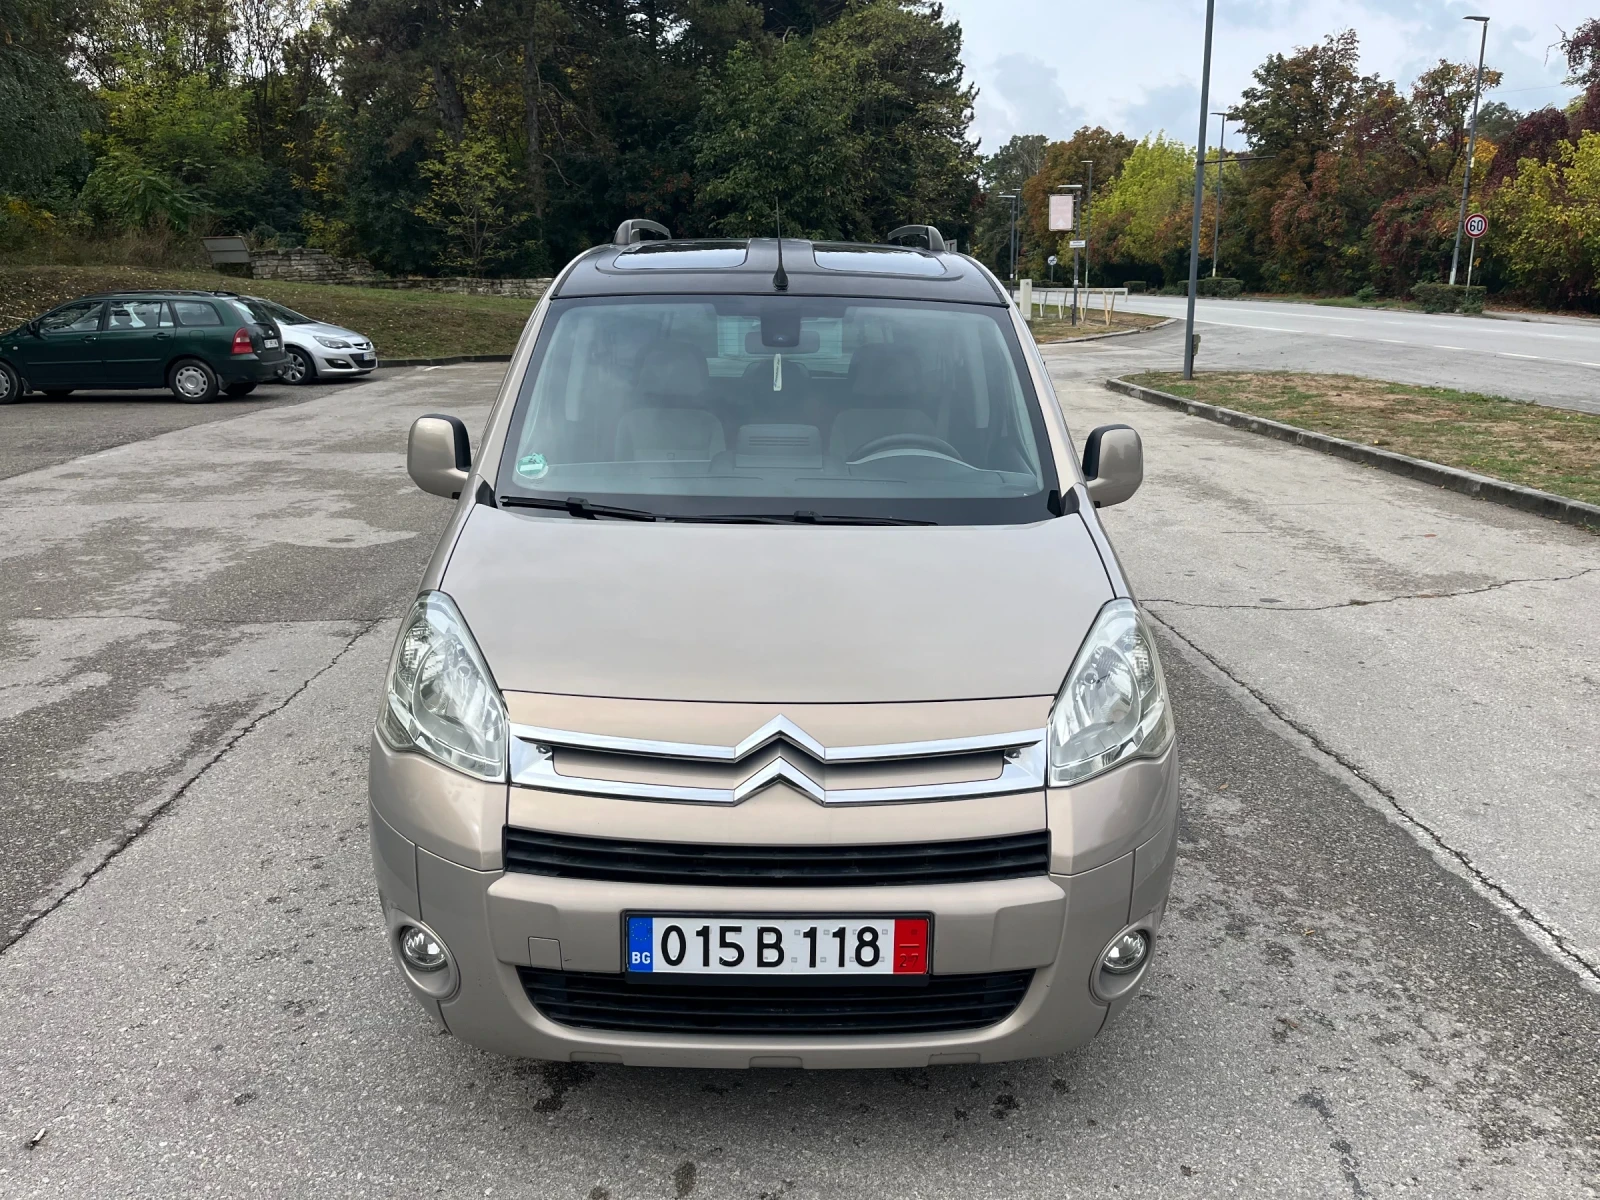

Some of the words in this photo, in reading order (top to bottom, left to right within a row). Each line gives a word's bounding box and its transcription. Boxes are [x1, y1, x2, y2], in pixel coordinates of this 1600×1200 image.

[1469, 219, 1484, 232] 60
[631, 951, 651, 965] BG
[899, 953, 919, 968] 27
